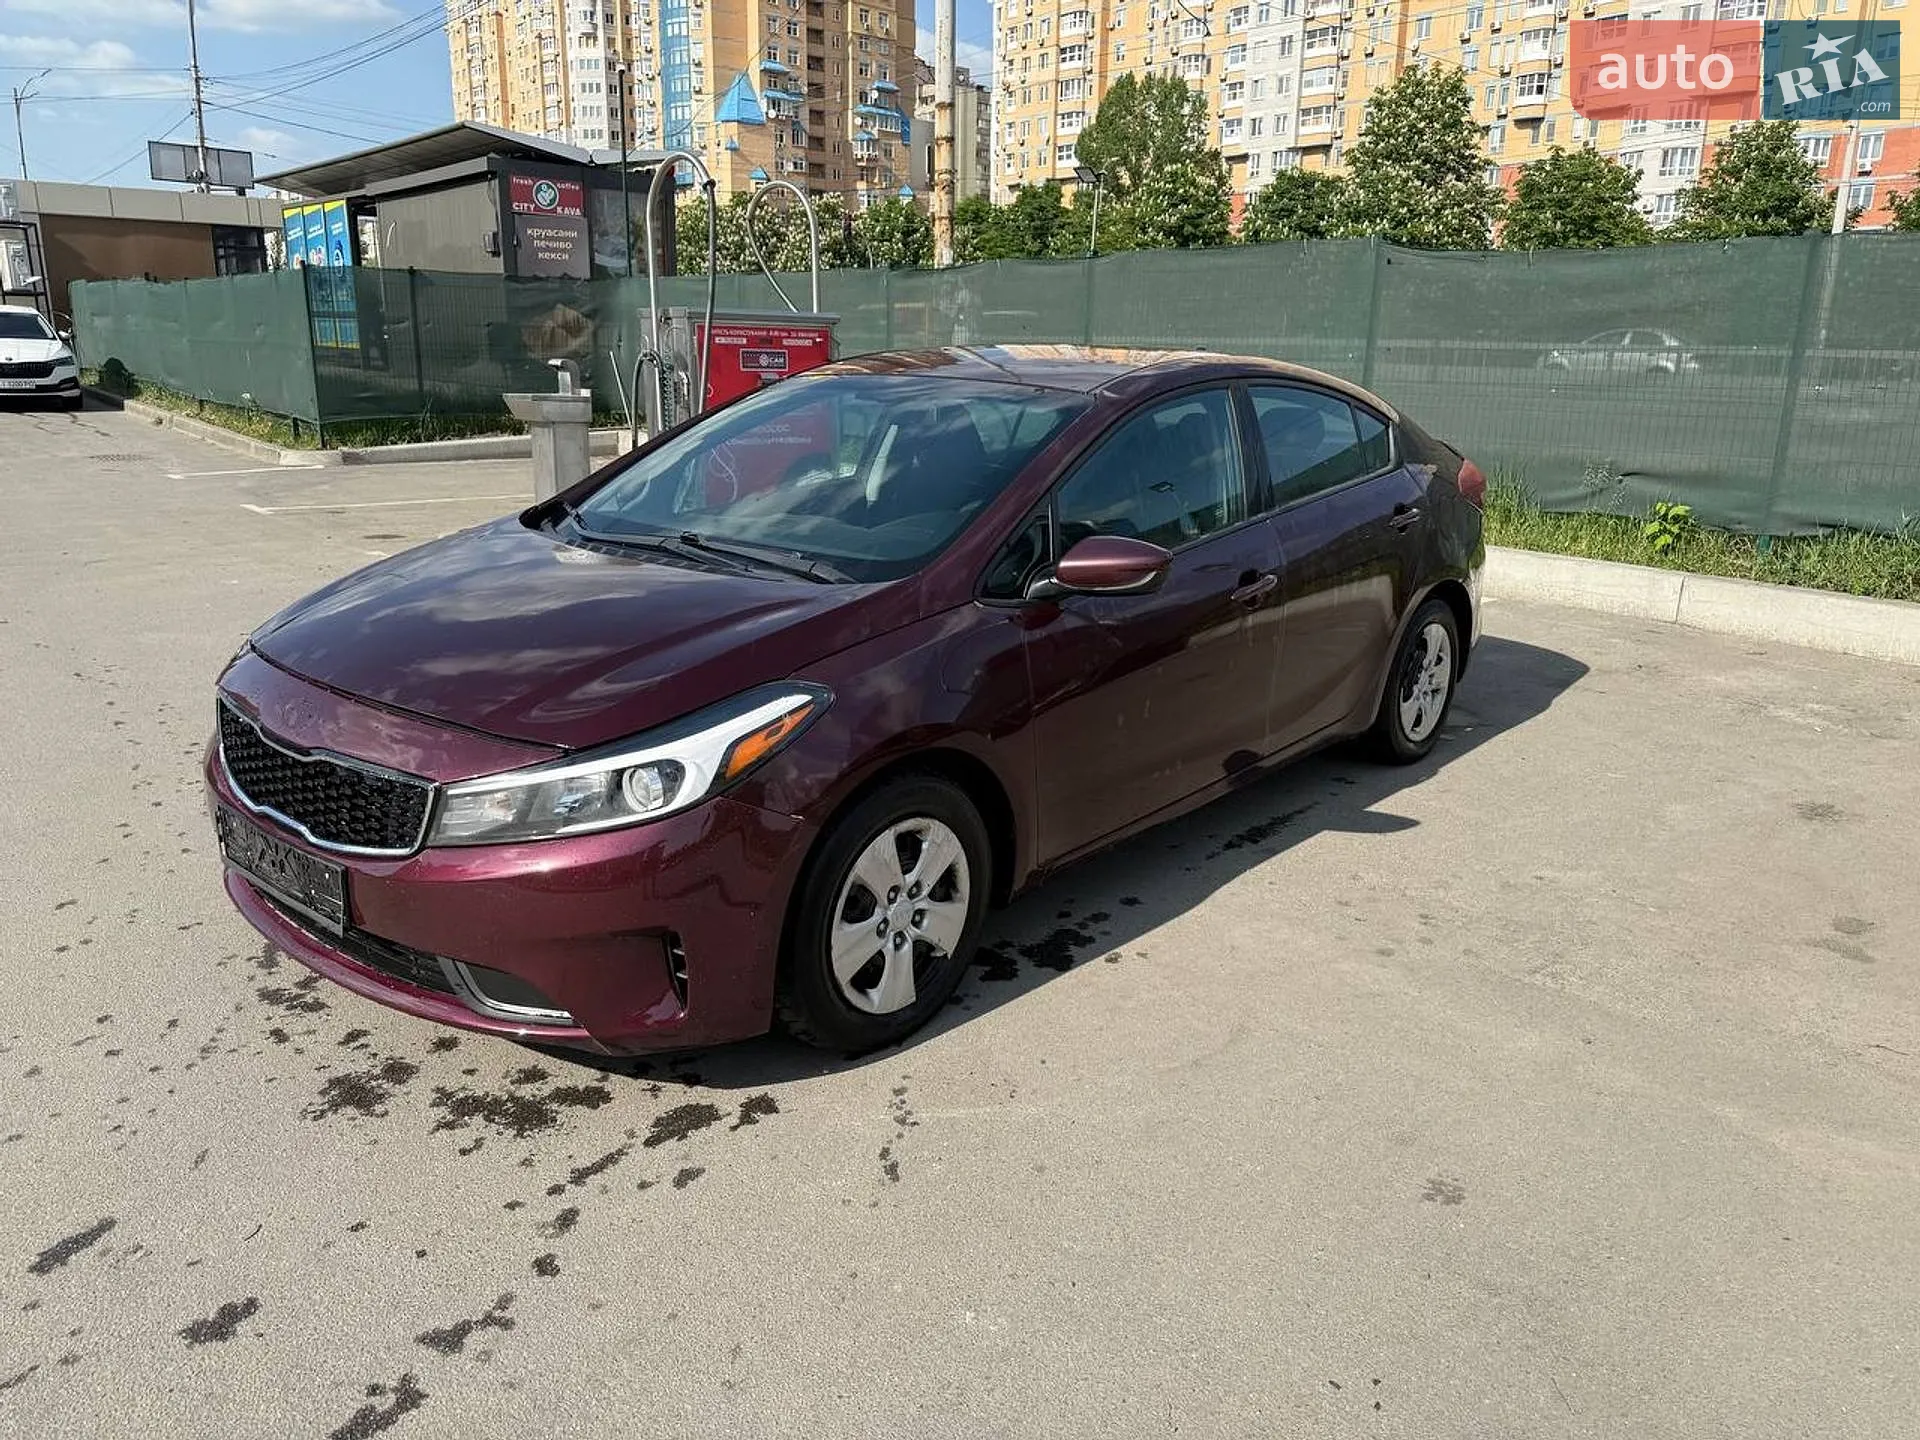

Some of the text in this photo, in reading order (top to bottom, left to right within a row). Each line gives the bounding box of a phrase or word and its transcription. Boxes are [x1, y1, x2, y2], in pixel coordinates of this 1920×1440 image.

[512, 202, 581, 216] CITY KAVA
[526, 227, 578, 239] круасани
[533, 240, 572, 249] печиво
[538, 252, 569, 261] кекси
